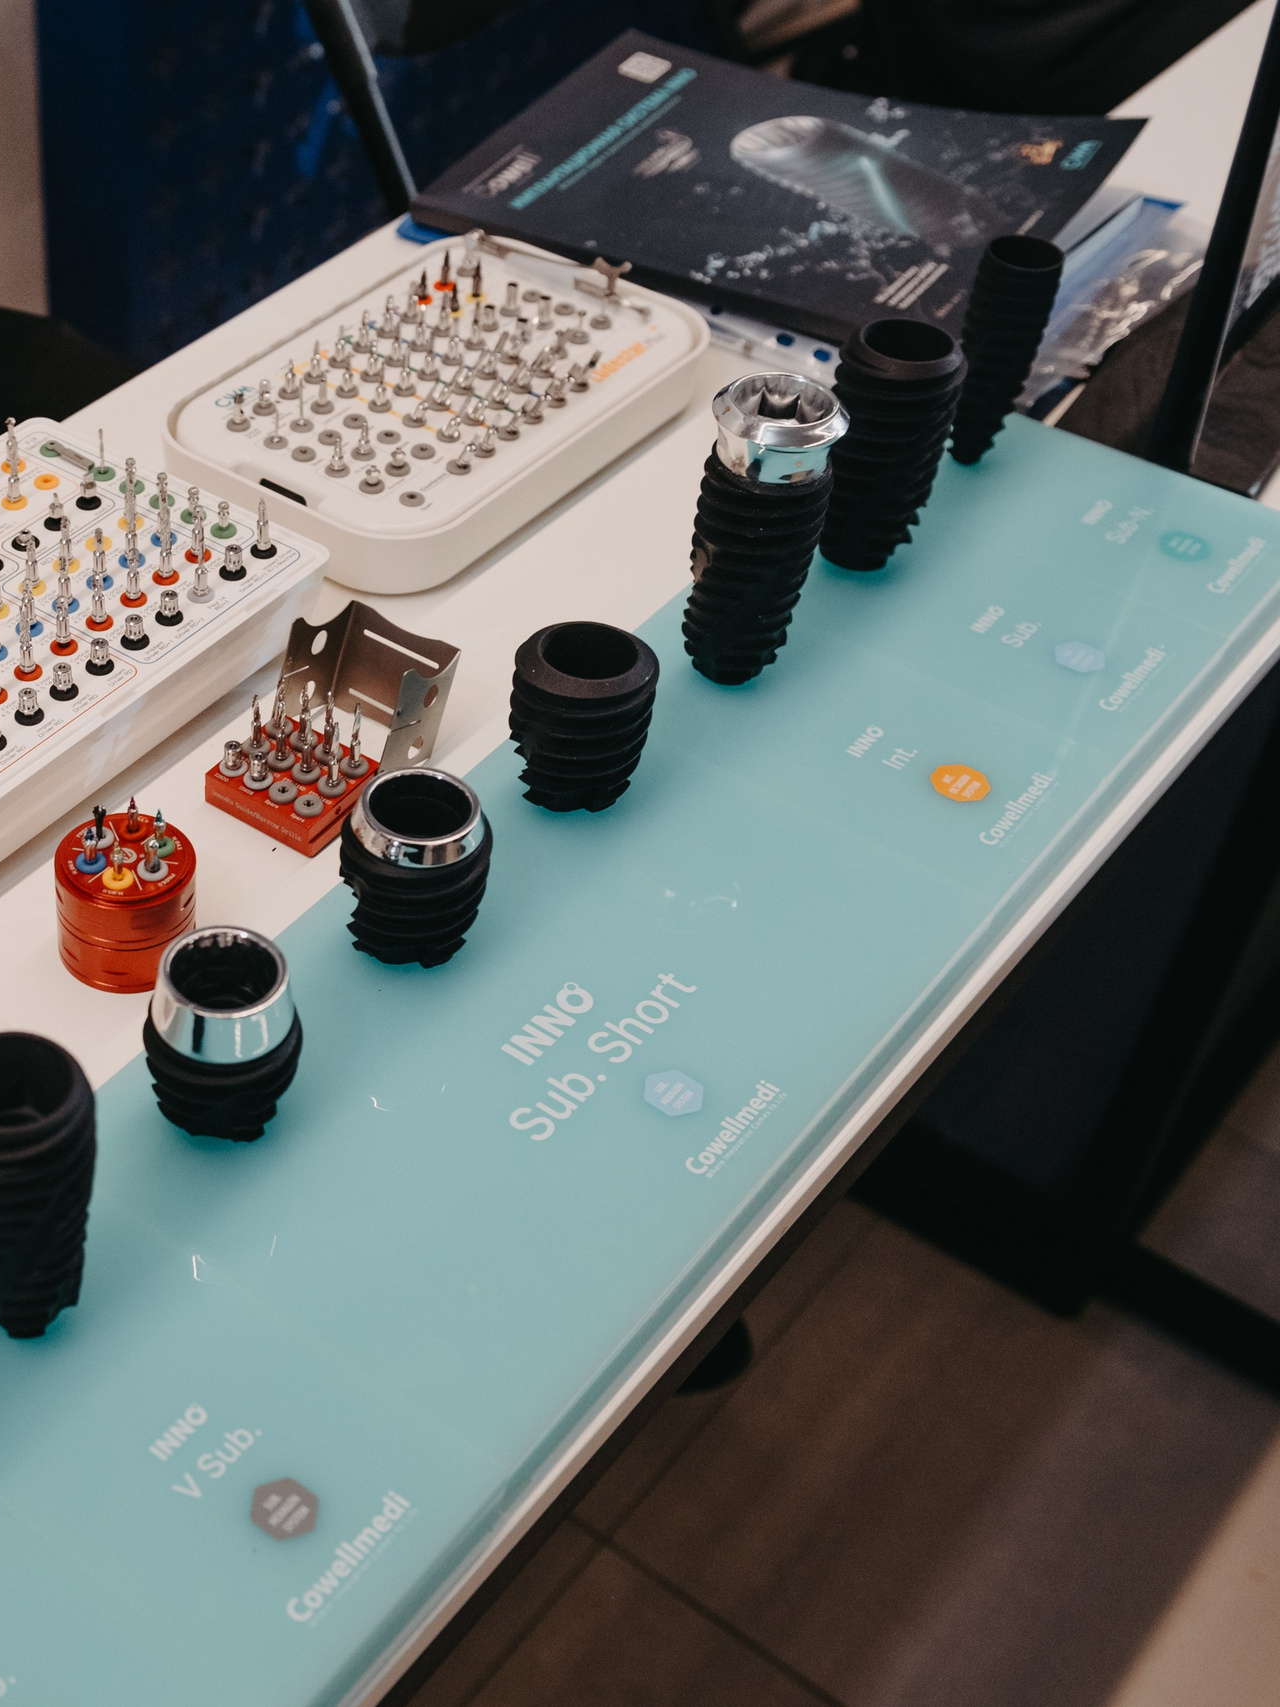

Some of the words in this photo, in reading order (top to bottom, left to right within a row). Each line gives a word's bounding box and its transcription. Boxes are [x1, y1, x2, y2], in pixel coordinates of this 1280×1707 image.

[1207, 536, 1267, 594] Cowellmedi
[970, 604, 1005, 634] INNO
[1001, 620, 1042, 648] Sub.
[1098, 646, 1166, 713] Cowellmedi
[846, 724, 884, 758] INNO
[882, 747, 919, 771] Int.
[264, 799, 280, 810] Spare
[281, 826, 302, 842] Drills
[290, 813, 306, 823] Spare
[979, 772, 1054, 846] Cowellmedi
[500, 981, 594, 1066] INNO
[509, 1072, 608, 1142] Sub.
[587, 972, 698, 1064] Short
[672, 1089, 695, 1111] SYSTEM
[686, 1080, 780, 1174] Cowellmedi
[705, 1158, 725, 1180] Where
[722, 1127, 753, 1161] Innovation
[750, 1108, 771, 1130] Comes
[767, 1101, 777, 1111] to
[774, 1091, 788, 1105] Life
[148, 1402, 209, 1463] INNO
[171, 1472, 205, 1502] V
[196, 1421, 264, 1480] Sub.
[286, 1490, 412, 1624] Cowellmedi
